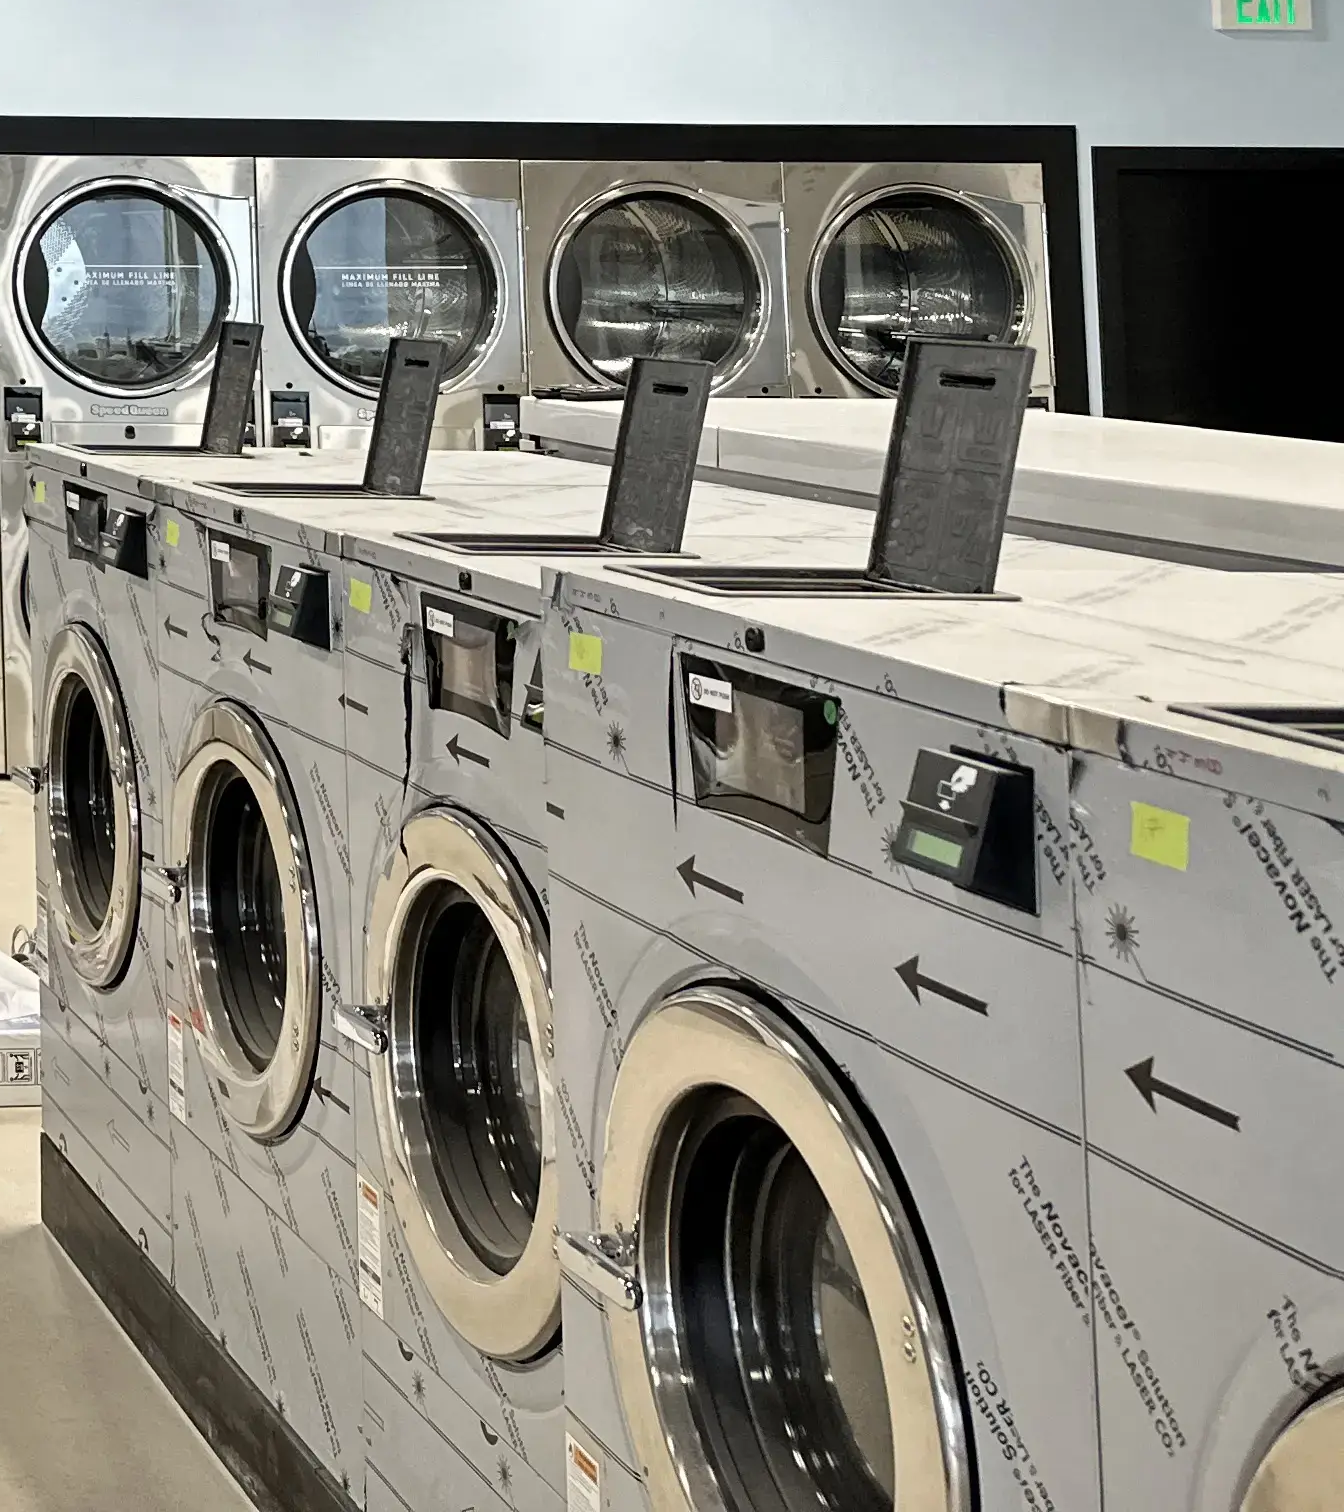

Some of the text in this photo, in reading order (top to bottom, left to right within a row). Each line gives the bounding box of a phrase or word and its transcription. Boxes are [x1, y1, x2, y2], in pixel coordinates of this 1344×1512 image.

[341, 273, 440, 281] MAXIMUM FILL LINE
[90, 404, 169, 417] Speed Queen
[1309, 936, 1337, 985] The
[1019, 1154, 1041, 1198] The
[1008, 1167, 1085, 1309] for LASER Fiber
[1121, 1347, 1156, 1415] LASER
[1137, 1349, 1187, 1448] Solution
[965, 1370, 1017, 1461] Solution
